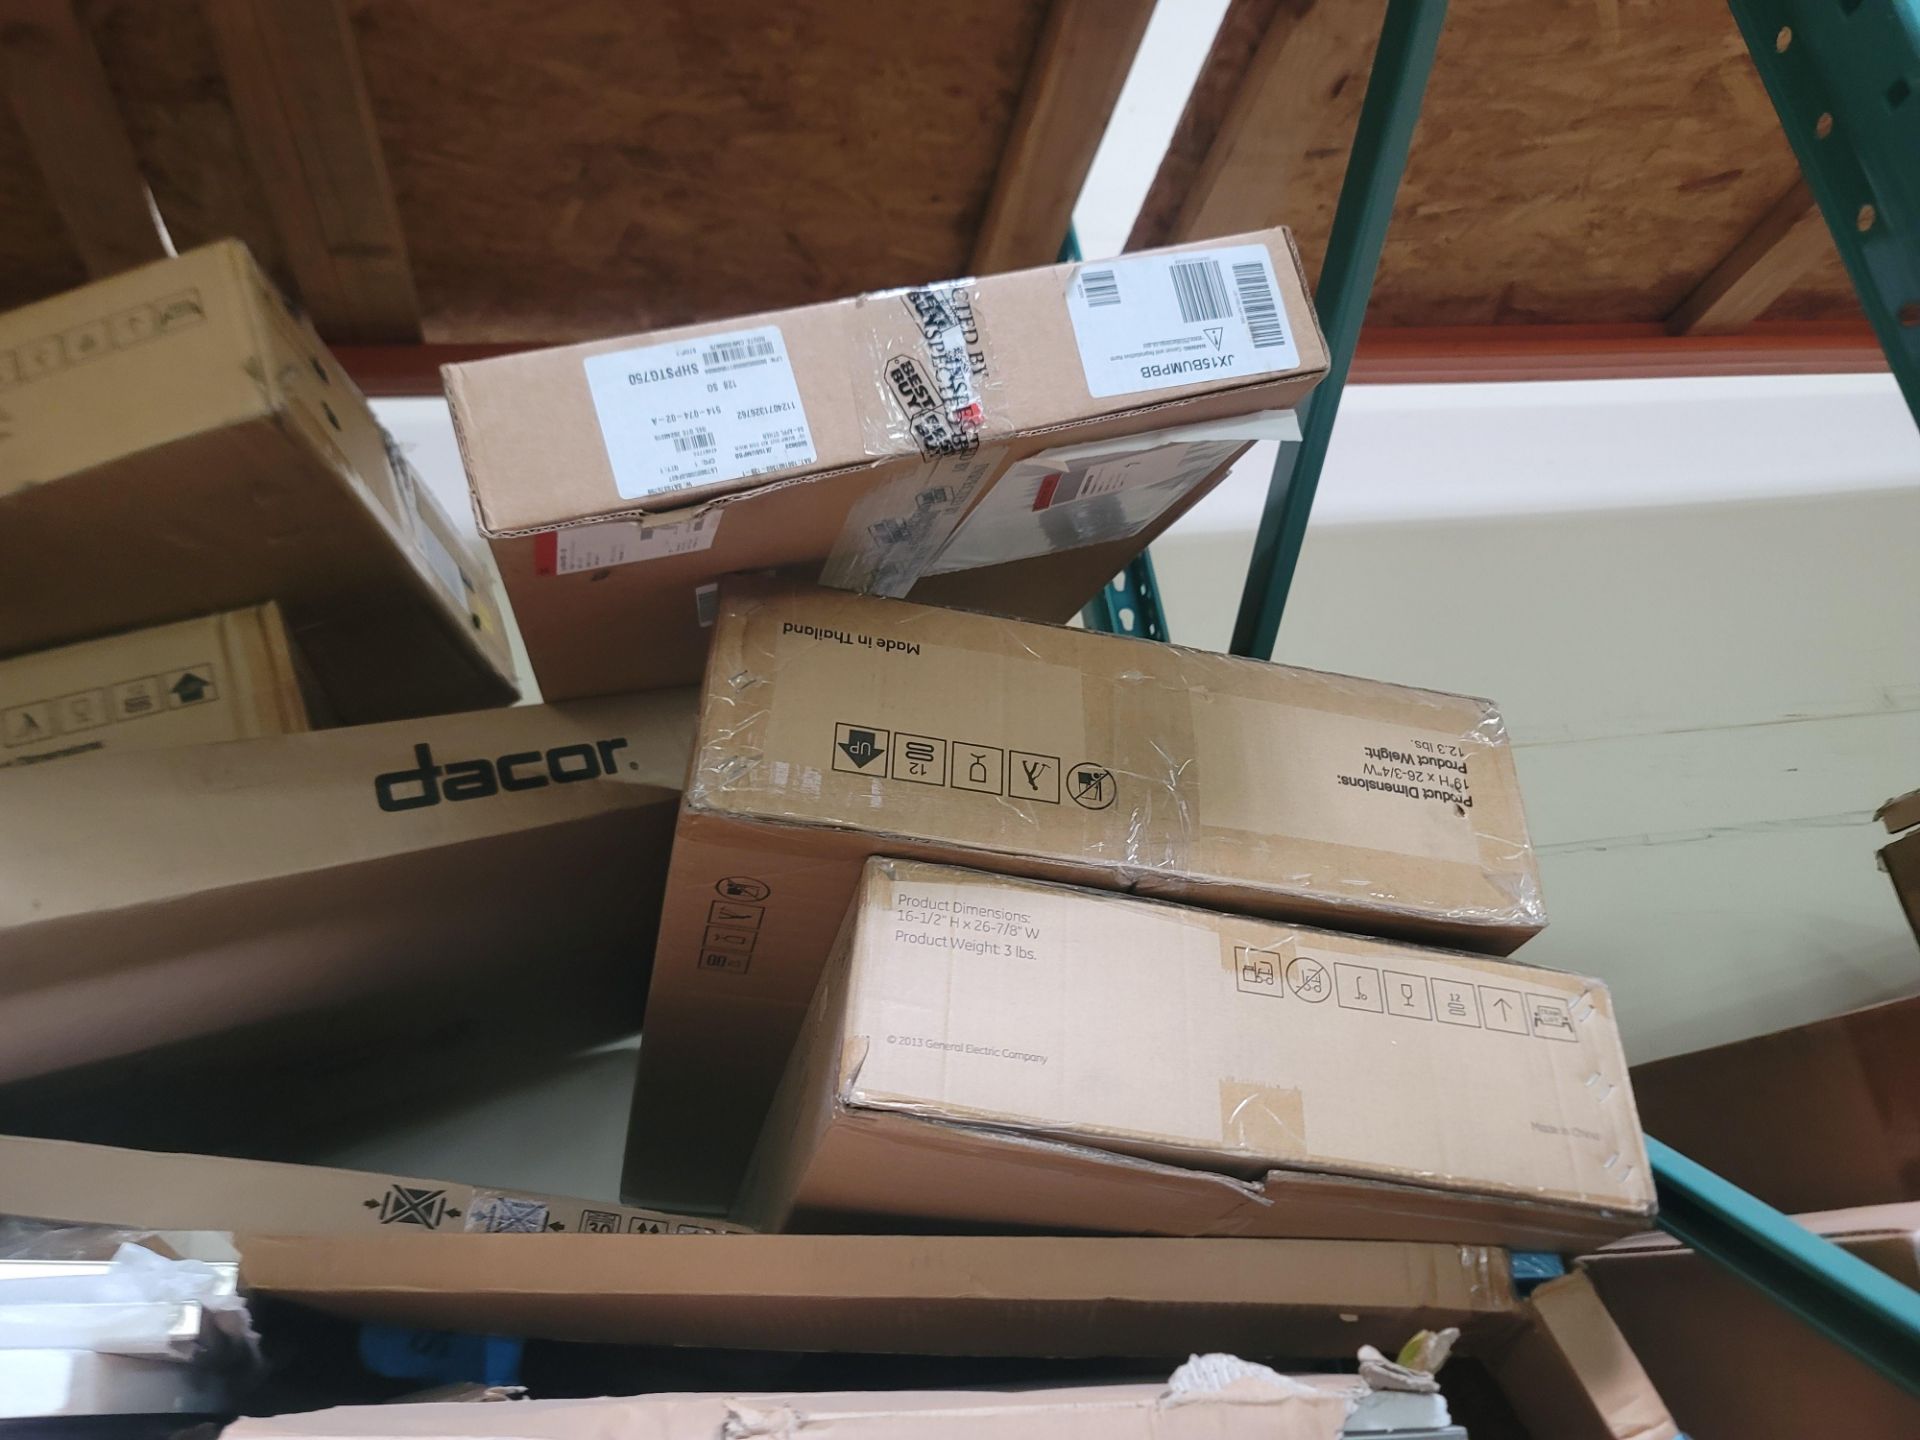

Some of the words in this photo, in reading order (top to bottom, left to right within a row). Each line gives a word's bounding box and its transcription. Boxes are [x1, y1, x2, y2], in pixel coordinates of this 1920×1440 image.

[628, 363, 699, 385] SHPSTG750
[1140, 354, 1235, 378] JX15BUMPBB
[891, 368, 921, 408] BUY
[900, 360, 936, 407] BEST
[651, 405, 721, 426] 514-074-02-A
[783, 622, 854, 645] Thailand
[858, 632, 873, 648] in
[877, 637, 921, 656] Made
[850, 741, 871, 755] UP
[1364, 746, 1414, 766] Weight:
[1410, 739, 1433, 752] lbs.
[1437, 743, 1465, 757] 12.3
[374, 737, 628, 812] dacor
[909, 761, 927, 776] 12
[1417, 758, 1467, 774] Product
[1337, 774, 1419, 799] Dimensions:
[1427, 772, 1435, 782] x
[1422, 788, 1473, 807] Product
[898, 894, 950, 912] Product
[952, 901, 1031, 923] Dimensions:
[898, 909, 947, 926] 16-1/2"
[950, 917, 960, 929] H
[962, 921, 971, 930] x
[974, 919, 1023, 937] 26-7/8"
[1024, 927, 1040, 940] W
[895, 930, 947, 948] Product
[1003, 944, 1012, 957] 3
[1015, 945, 1037, 960] lbs.
[1448, 992, 1462, 1002] 12
[899, 1036, 923, 1048] 2013
[925, 1039, 963, 1053] General
[965, 1043, 1000, 1057] Electric
[1001, 1048, 1048, 1065] Company
